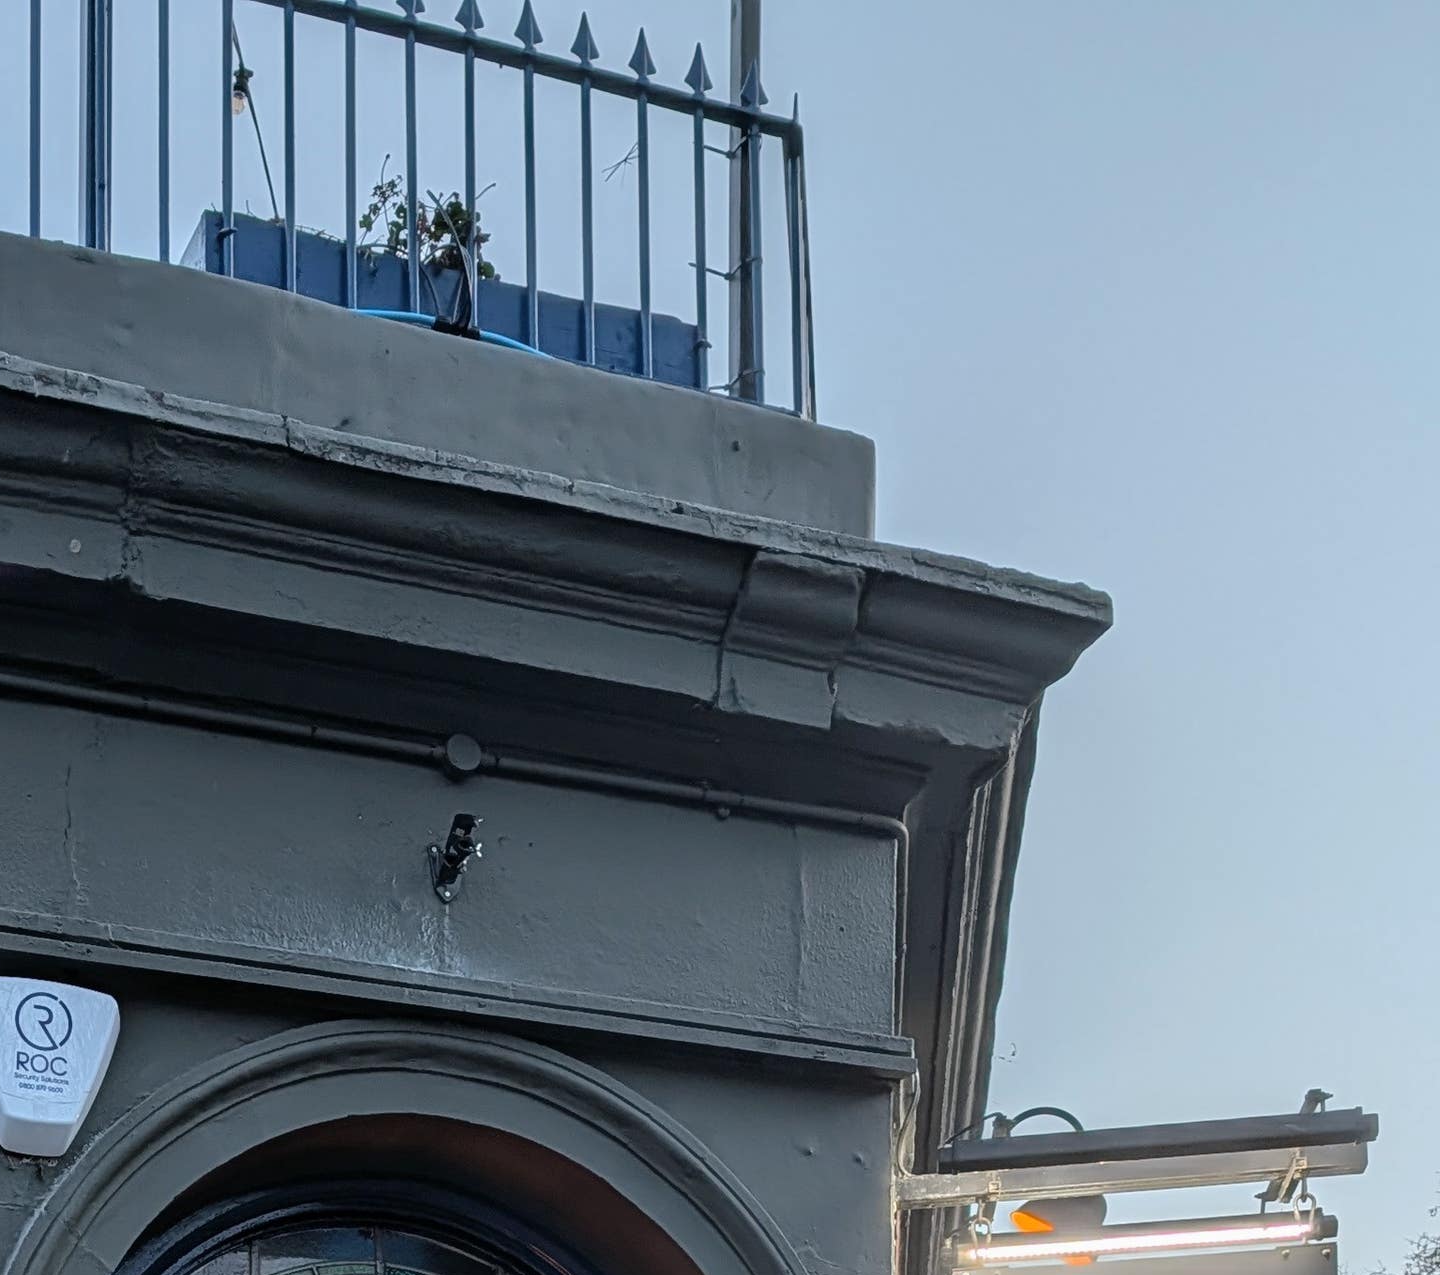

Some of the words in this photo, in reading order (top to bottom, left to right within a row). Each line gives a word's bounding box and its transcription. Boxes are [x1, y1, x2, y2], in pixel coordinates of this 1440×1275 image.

[16, 1051, 67, 1076] ROC
[14, 1072, 40, 1082] Security
[41, 1075, 69, 1086] Solutions
